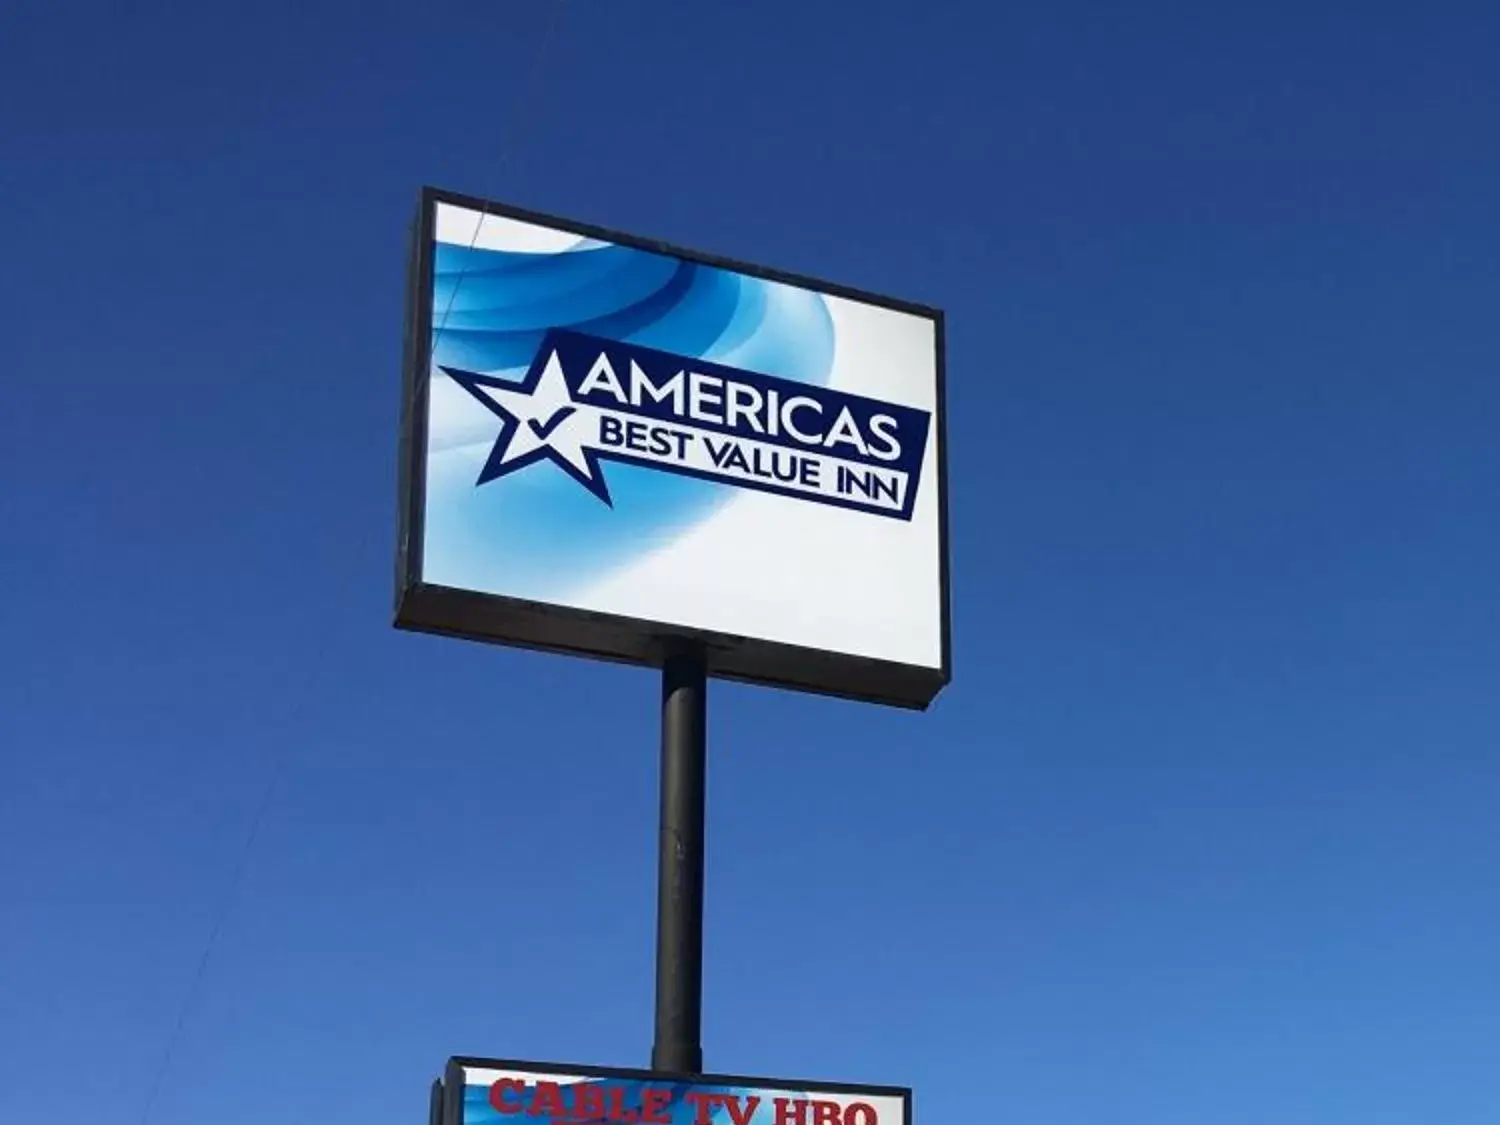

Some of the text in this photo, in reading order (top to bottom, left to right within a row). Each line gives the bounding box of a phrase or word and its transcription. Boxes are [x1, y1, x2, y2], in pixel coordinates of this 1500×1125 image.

[576, 350, 902, 461] AMERICAS
[598, 415, 899, 504] BEST VALUE INN
[488, 1077, 672, 1124] CABLE
